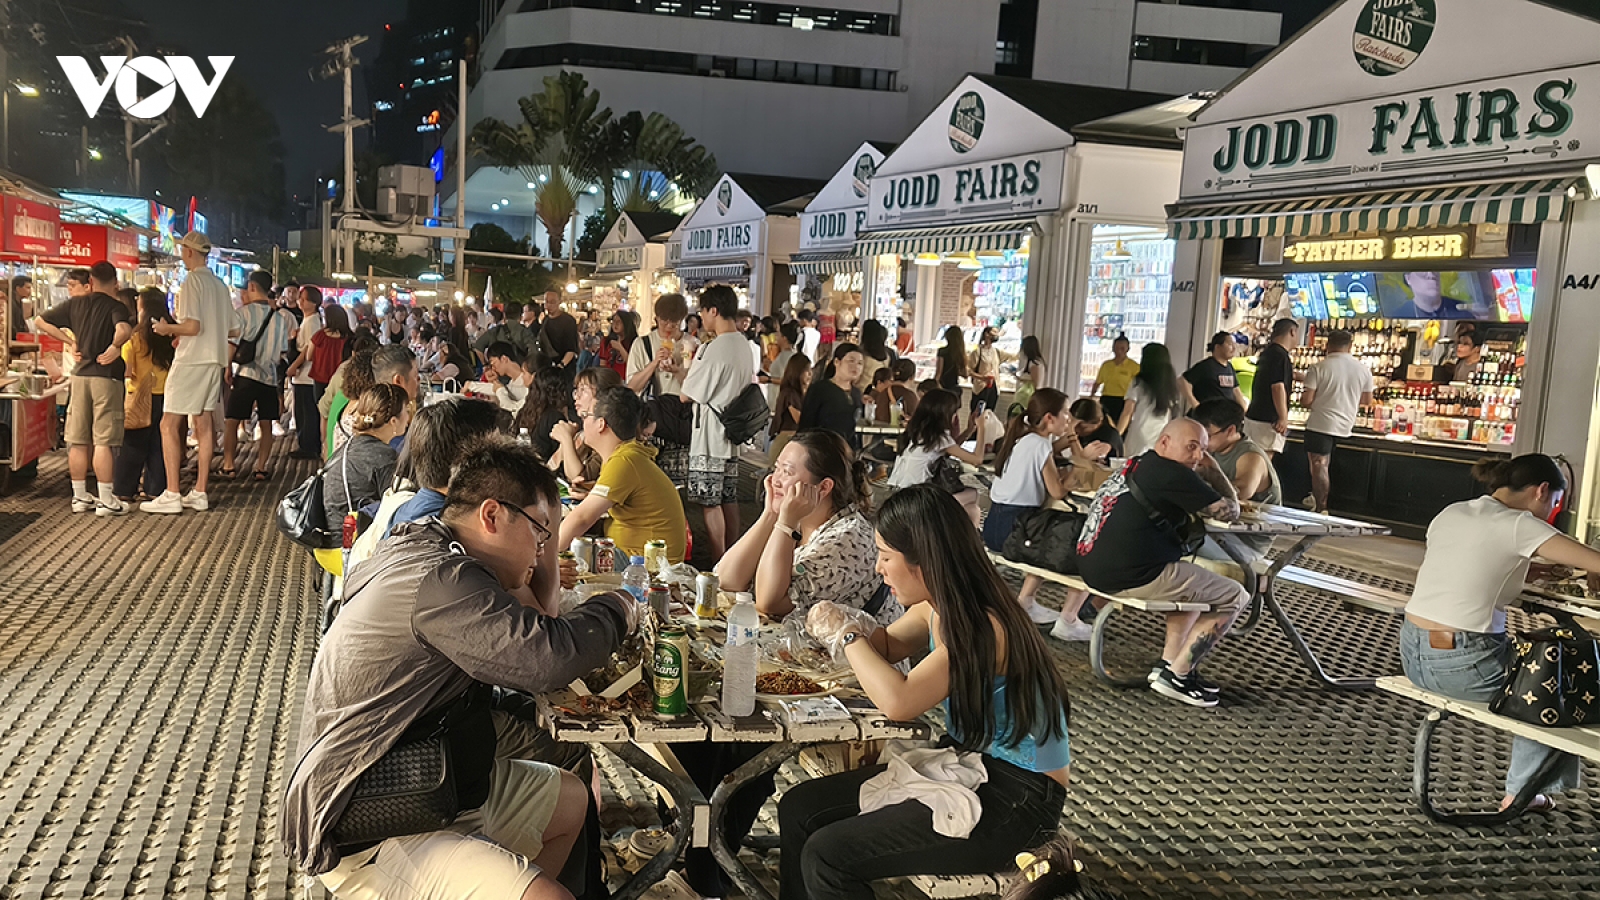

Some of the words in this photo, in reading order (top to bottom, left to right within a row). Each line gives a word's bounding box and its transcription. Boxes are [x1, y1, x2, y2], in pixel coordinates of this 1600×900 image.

[1370, 10, 1413, 46] FAIRS
[1356, 38, 1406, 65] Ratchada
[1213, 112, 1338, 174] JODD
[1367, 77, 1577, 155] FAIRS
[883, 173, 941, 210] JODD
[954, 160, 1041, 204] FAIRS
[687, 229, 713, 251] JODD
[717, 224, 752, 249] FAIRS
[809, 212, 847, 239] JODD
[1293, 238, 1384, 263] FATHER
[1391, 233, 1463, 260] BEER
[1563, 274, 1600, 290] A4/
[653, 662, 680, 677] hang
